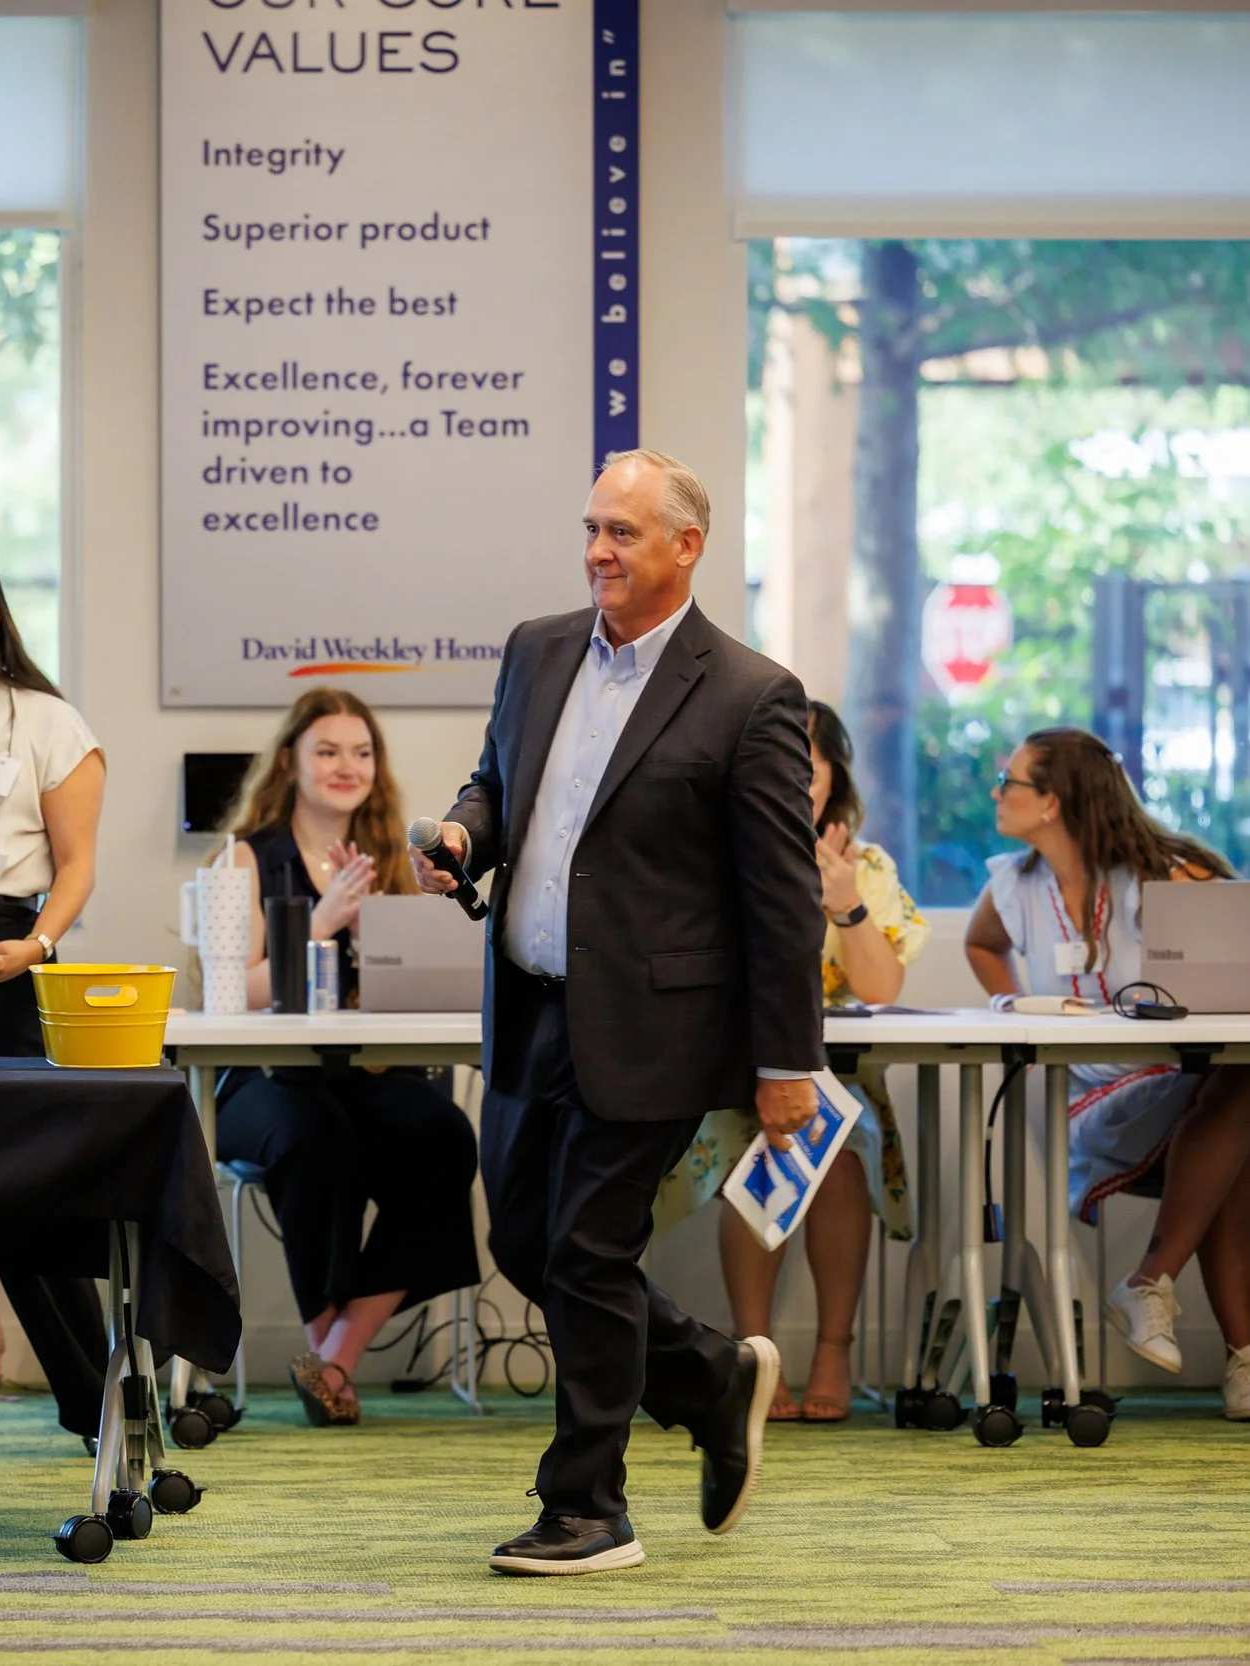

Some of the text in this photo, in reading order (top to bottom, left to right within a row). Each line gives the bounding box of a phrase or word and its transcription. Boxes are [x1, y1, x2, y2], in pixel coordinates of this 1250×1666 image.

[202, 31, 459, 74] VALUES
[203, 139, 344, 175] Integrity
[203, 212, 490, 249] Superior product
[601, 136, 627, 323] believe
[204, 287, 457, 324] Expect the best
[204, 361, 524, 394] Excellence, forever
[609, 359, 627, 416] we
[441, 410, 529, 437] Team
[202, 456, 352, 484] driven to
[202, 502, 378, 531] excellence
[242, 637, 505, 665] David Weekley Home
